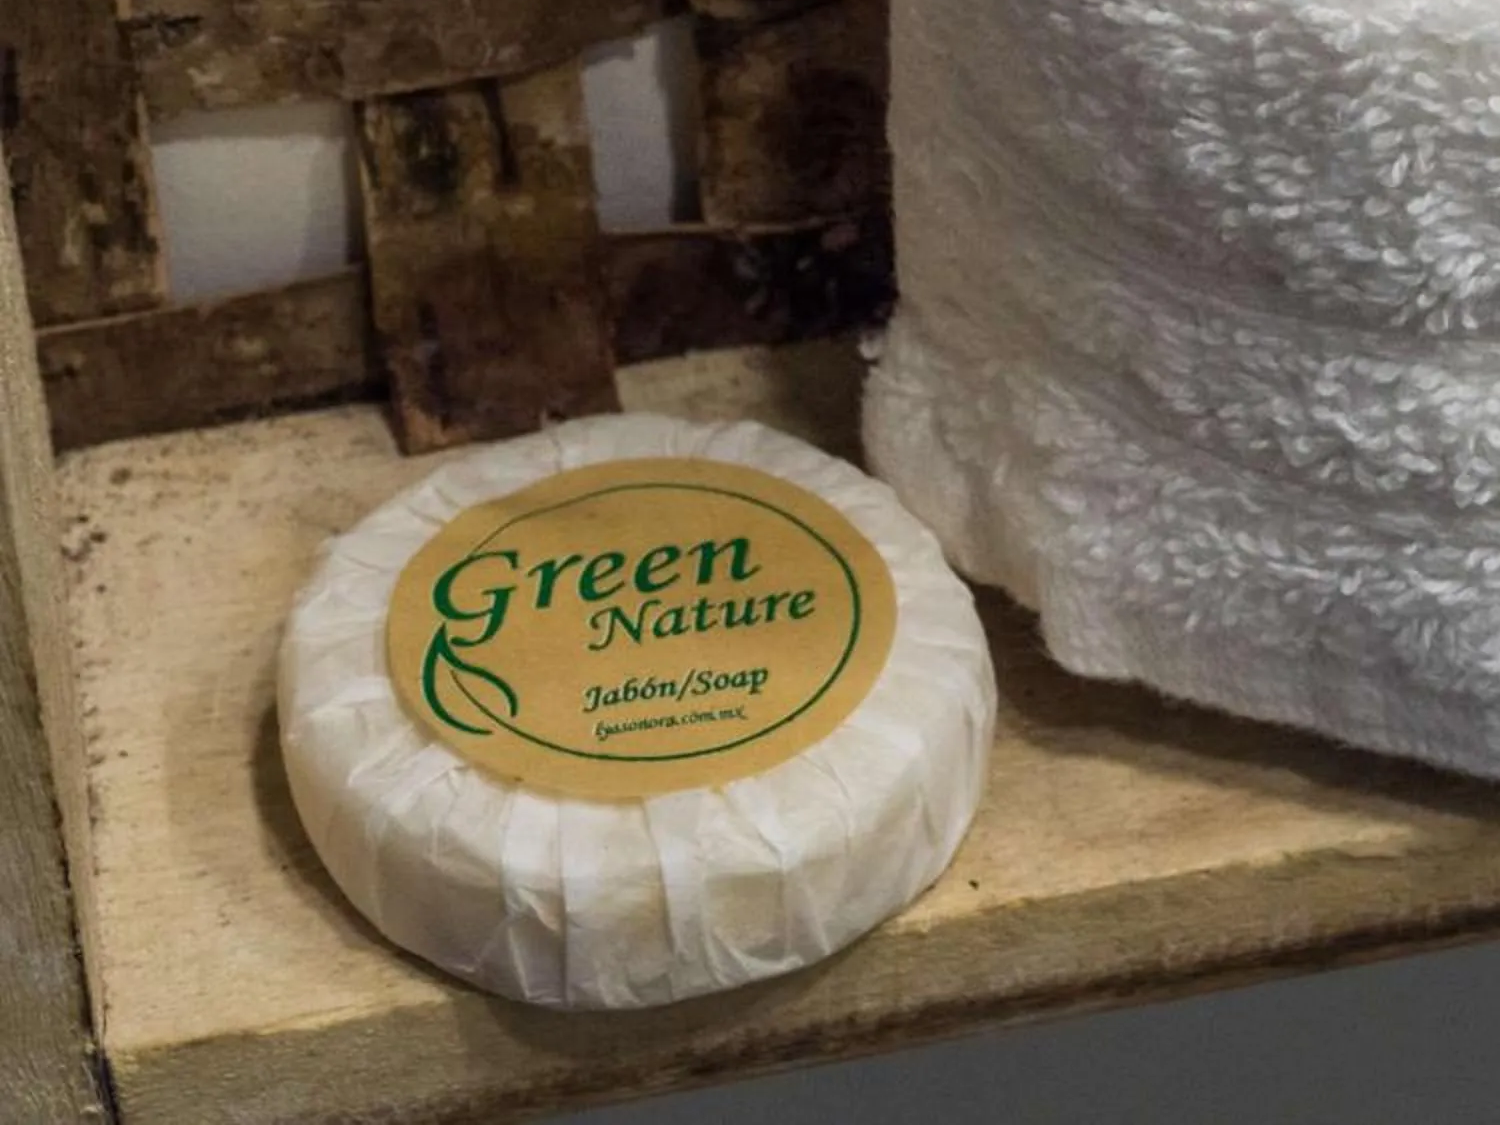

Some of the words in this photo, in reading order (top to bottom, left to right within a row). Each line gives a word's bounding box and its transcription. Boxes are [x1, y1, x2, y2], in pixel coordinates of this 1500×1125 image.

[431, 534, 762, 649] Green
[587, 589, 817, 652] Nature
[582, 666, 769, 714] Jabón/Soap
